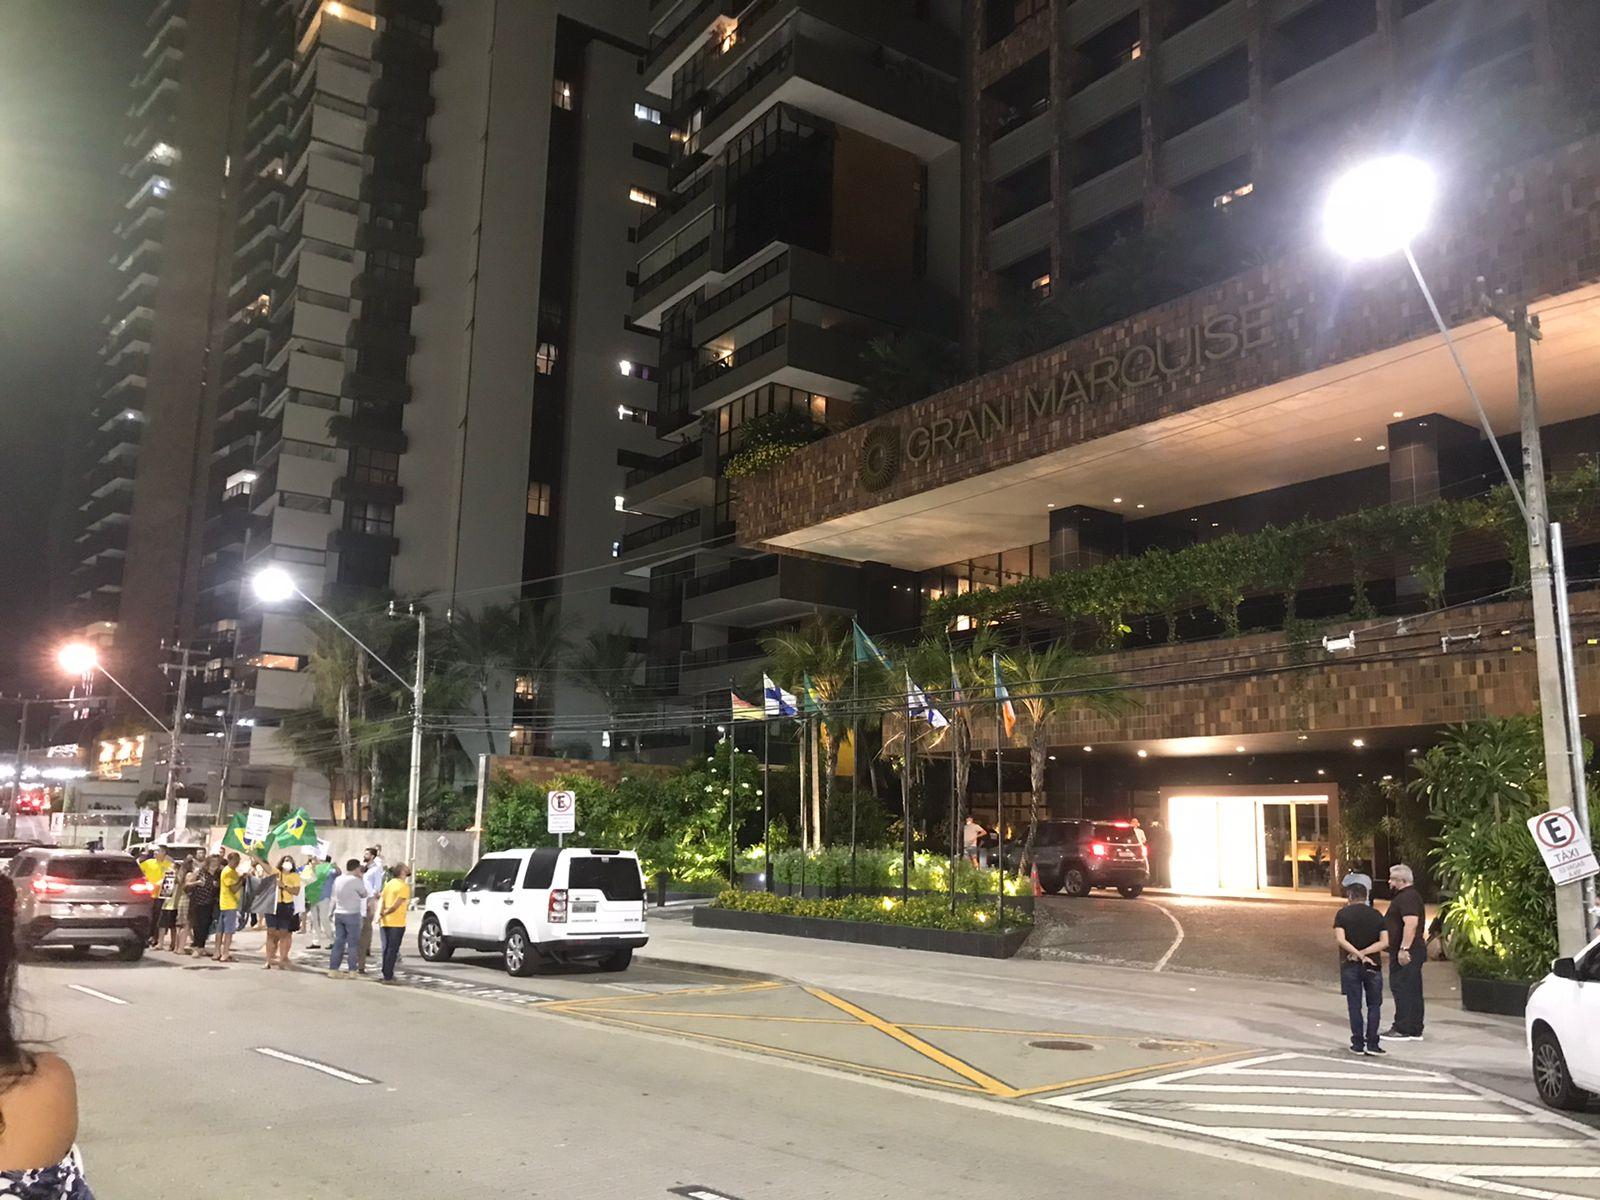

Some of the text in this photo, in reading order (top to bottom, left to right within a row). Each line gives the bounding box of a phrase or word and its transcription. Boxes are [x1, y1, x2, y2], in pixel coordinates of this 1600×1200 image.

[906, 302, 1273, 463] GRAN MARQUISE
[1544, 817, 1567, 843] E
